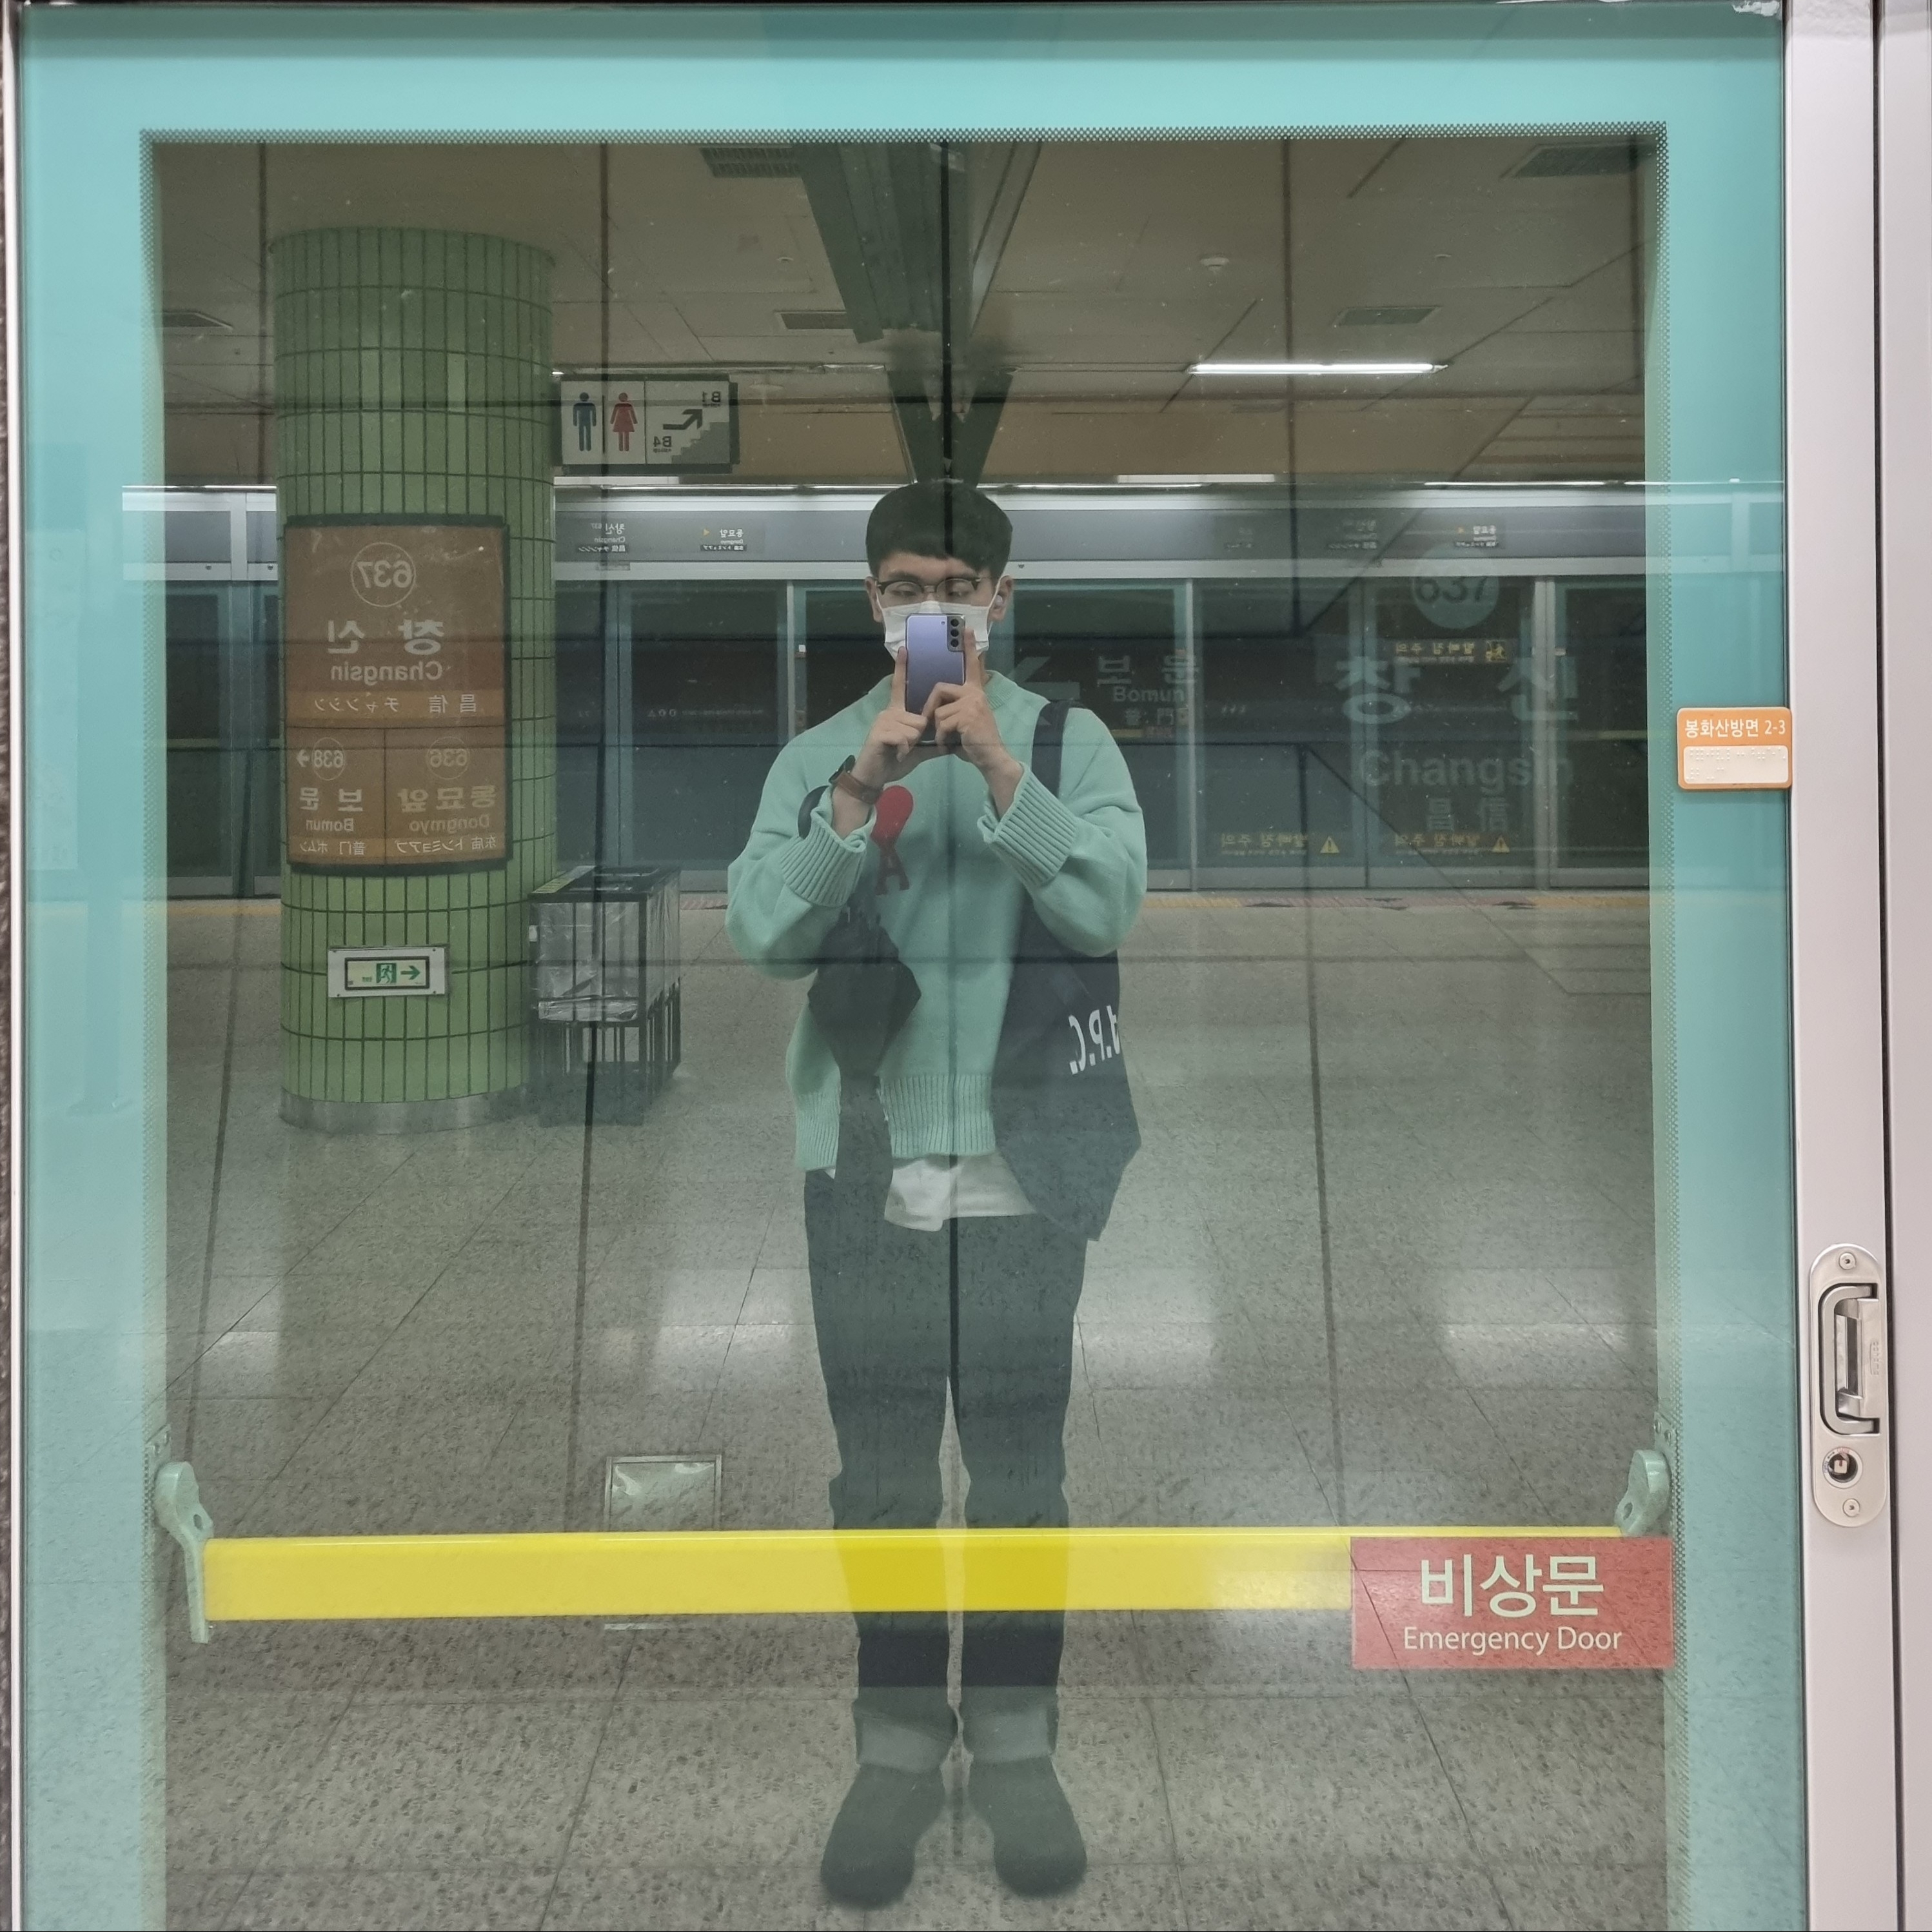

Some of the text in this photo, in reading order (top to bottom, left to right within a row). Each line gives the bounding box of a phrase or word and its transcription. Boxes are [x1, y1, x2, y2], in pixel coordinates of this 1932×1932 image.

[1113, 686, 1185, 703] Bomun
[1684, 718, 1786, 738] 봉화산방면 2-3
[1358, 749, 1574, 794] Changsn
[1421, 1553, 1604, 1618] 비상문
[1404, 1626, 1622, 1656] Emergency Door
